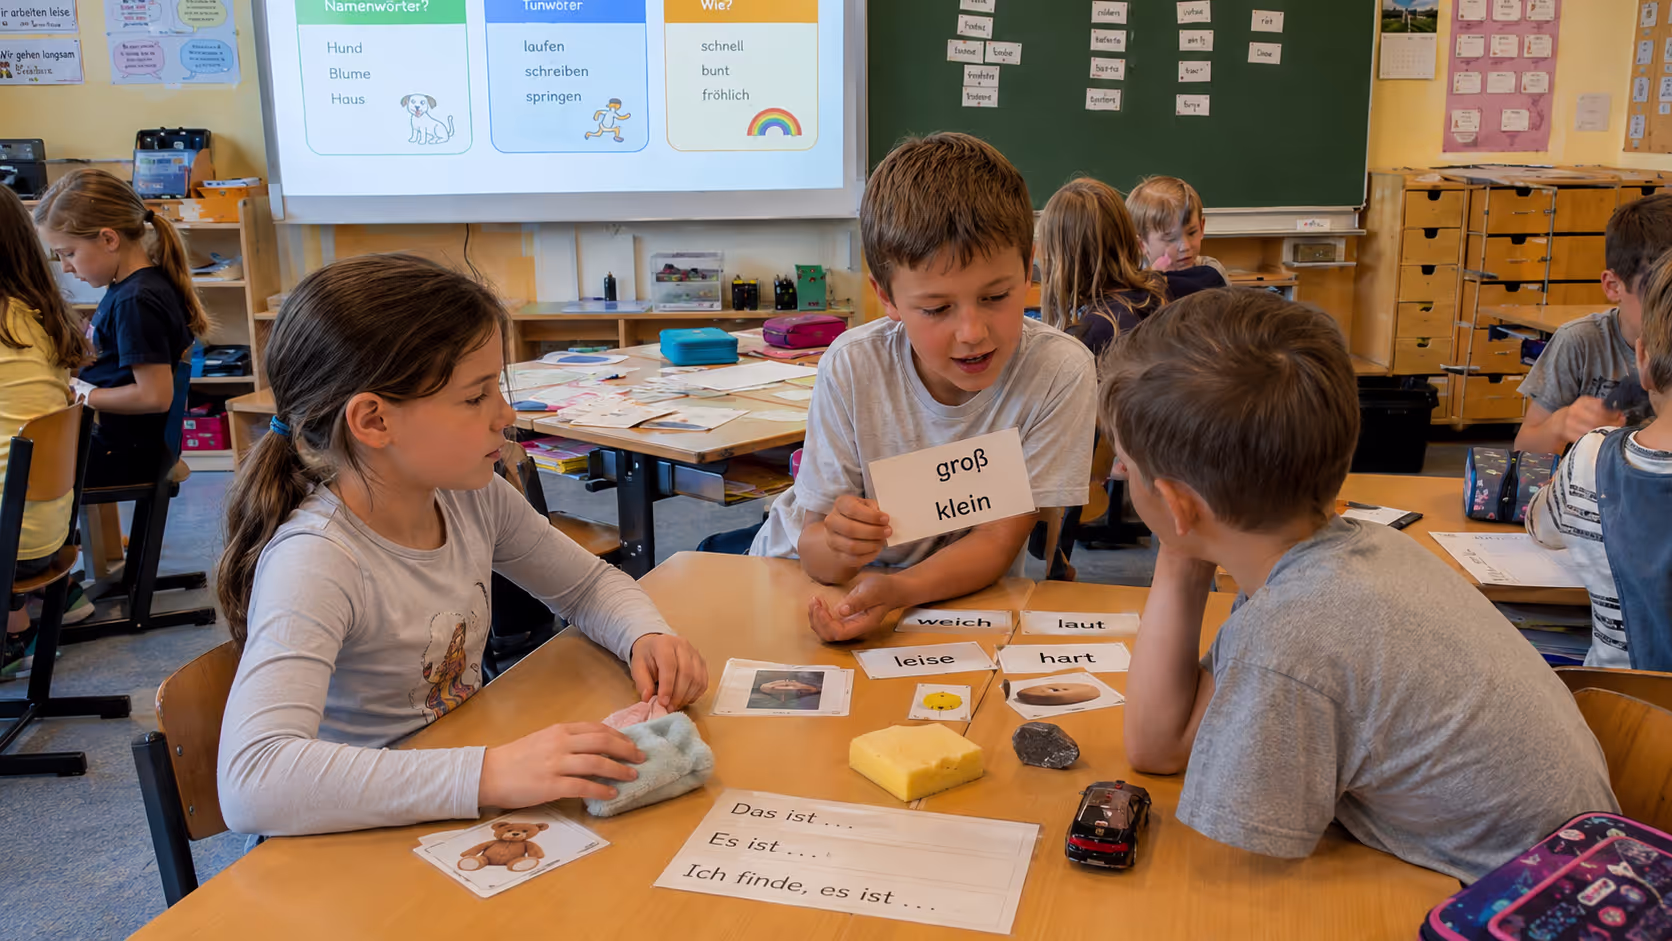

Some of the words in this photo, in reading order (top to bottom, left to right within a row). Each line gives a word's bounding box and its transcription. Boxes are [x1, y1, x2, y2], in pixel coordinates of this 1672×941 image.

[324, 0, 429, 12] Namenwörter?
[701, 0, 733, 11] Wie?
[11, 8, 47, 17] arbeiten
[49, 7, 71, 17] leise
[327, 42, 363, 54] Hund
[524, 40, 565, 52] laufen
[701, 40, 744, 52] schnell
[16, 49, 40, 63] gehen
[42, 50, 75, 61] langsam
[329, 68, 371, 80] Blume
[525, 65, 589, 77] schreiben
[701, 64, 730, 76] bunt
[331, 93, 365, 105] Haus
[526, 91, 582, 105] springen
[702, 89, 750, 101] fröhlich
[936, 448, 989, 482] groß
[935, 494, 992, 521] klein
[917, 617, 992, 628] weich
[1058, 618, 1106, 630] laut
[894, 653, 955, 668] leise
[1039, 652, 1097, 665] hart
[730, 802, 778, 819] Das
[786, 810, 818, 824] ist
[708, 832, 740, 848] Es
[747, 837, 780, 853] ist
[682, 863, 727, 882] Ich
[735, 871, 808, 895] finde,
[820, 886, 850, 898] es
[860, 887, 895, 904] ist
